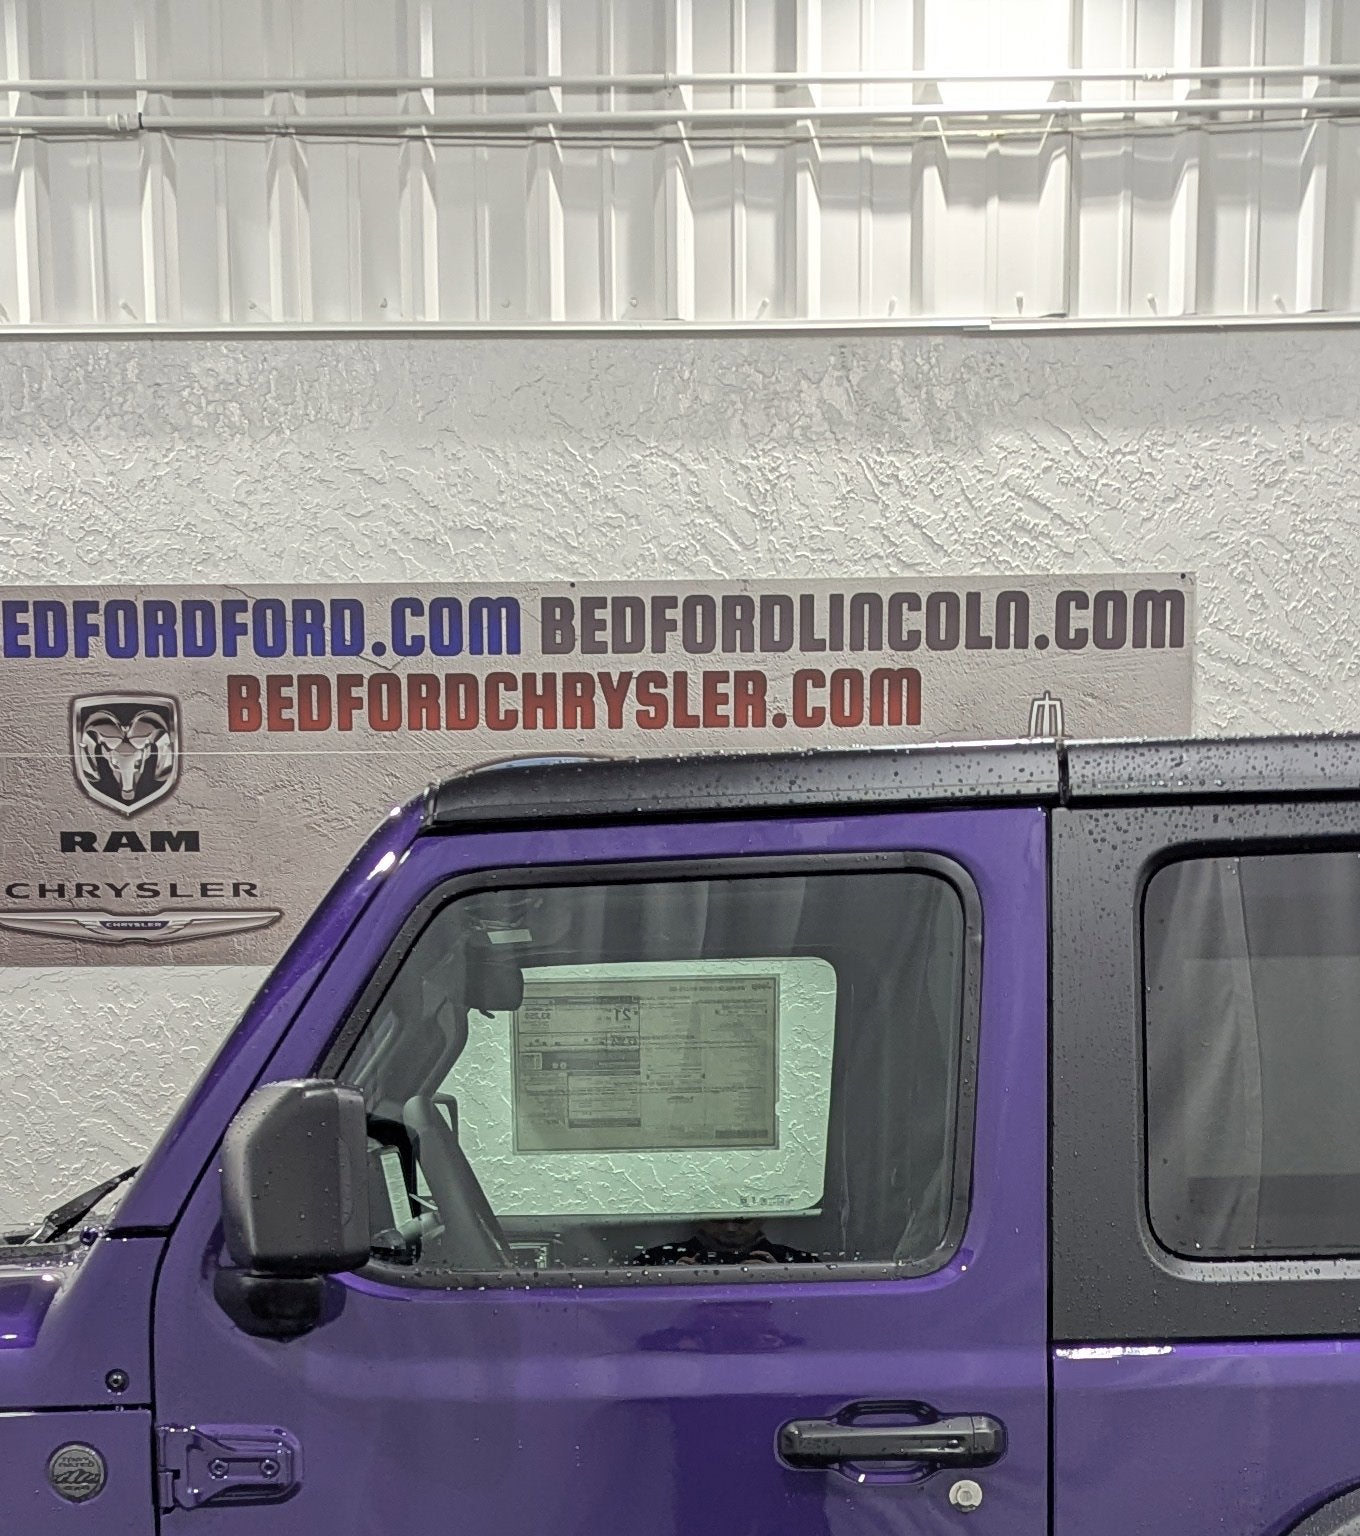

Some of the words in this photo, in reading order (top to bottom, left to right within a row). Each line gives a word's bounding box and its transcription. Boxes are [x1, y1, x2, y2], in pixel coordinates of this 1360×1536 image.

[541, 589, 1186, 655] BEDFORDLINCOLN.COM
[227, 667, 922, 733] BEDFORDCHRYSLER.COM
[59, 830, 201, 853] RAM
[4, 881, 260, 899] CHRYSLER
[105, 921, 163, 929] CHRYSLER
